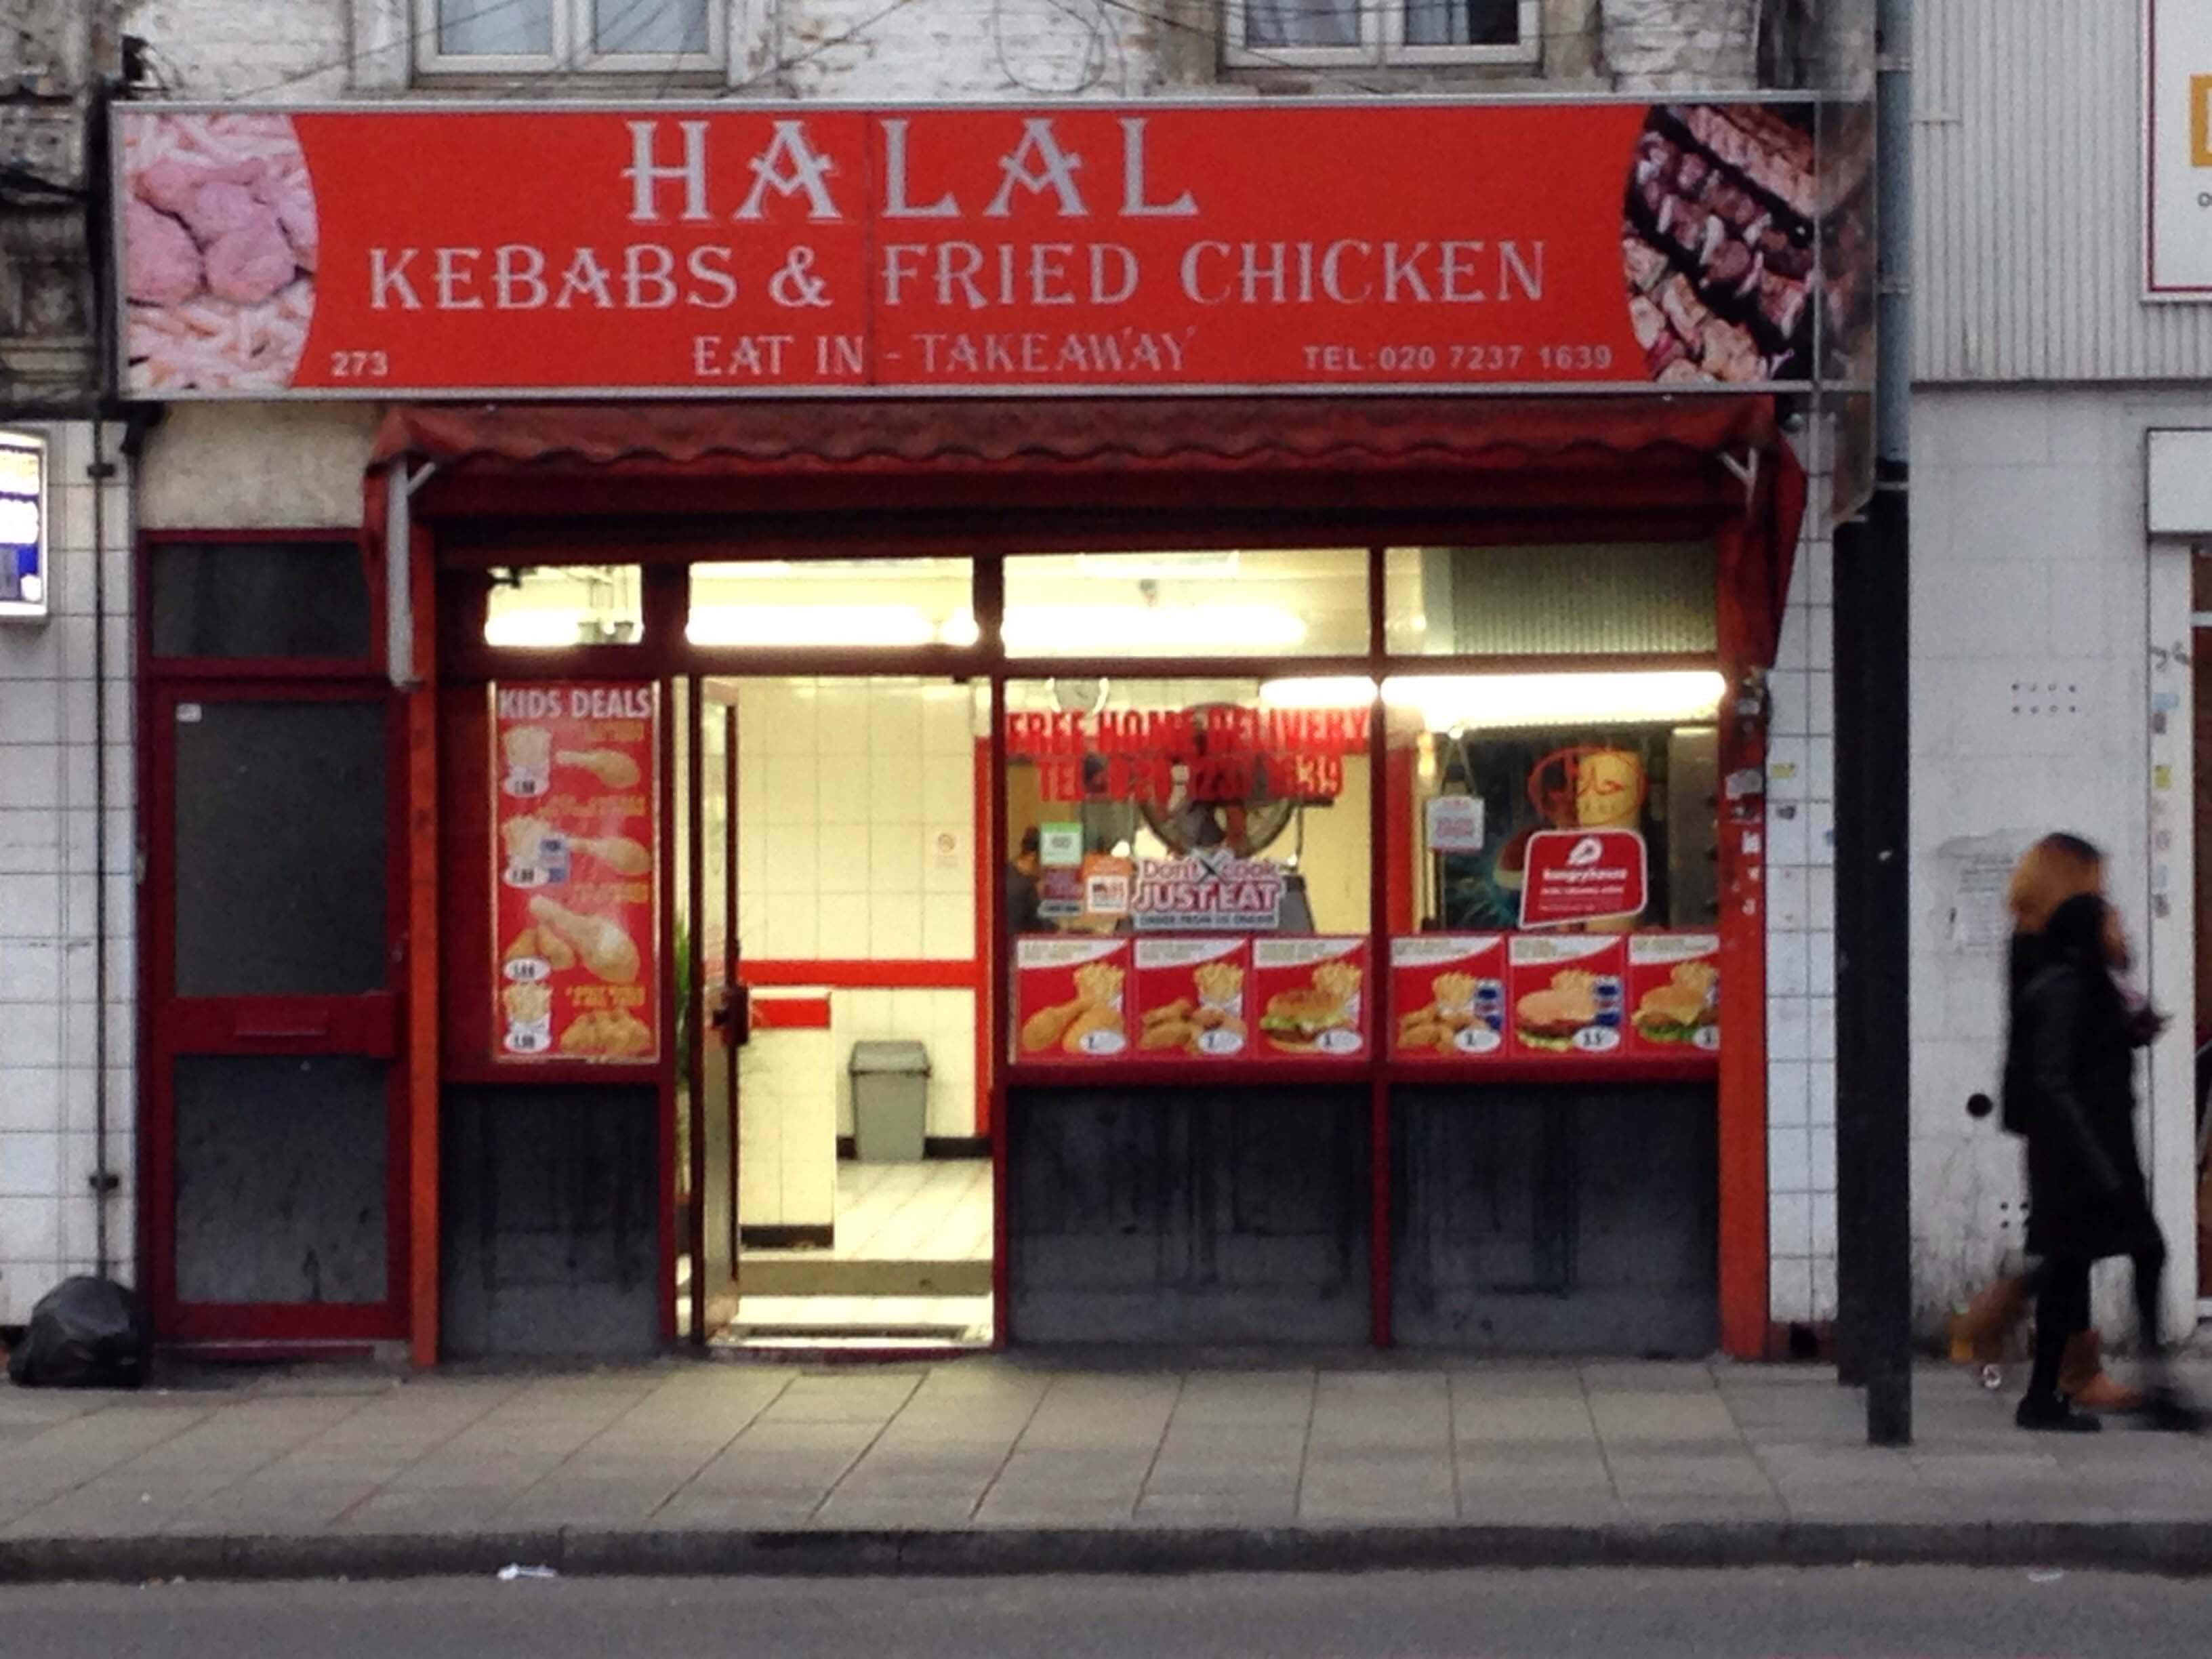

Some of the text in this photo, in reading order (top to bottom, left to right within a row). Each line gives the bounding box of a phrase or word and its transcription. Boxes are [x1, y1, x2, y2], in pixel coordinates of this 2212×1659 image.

[621, 117, 1197, 222] HALAL
[369, 239, 1544, 310] KEBABS & FRIED CHICKEN
[330, 350, 388, 377] 273
[693, 335, 794, 376] EAT
[815, 335, 864, 375] IN
[912, 326, 1195, 373] TAKEAWAY
[1448, 344, 1524, 371] 7237
[1538, 344, 1613, 371] 1639
[498, 689, 651, 718] KIDS DEALS
[1007, 710, 1086, 754] FREE
[1208, 708, 1370, 754] DELIVERY
[1220, 883, 1277, 911] EAT
